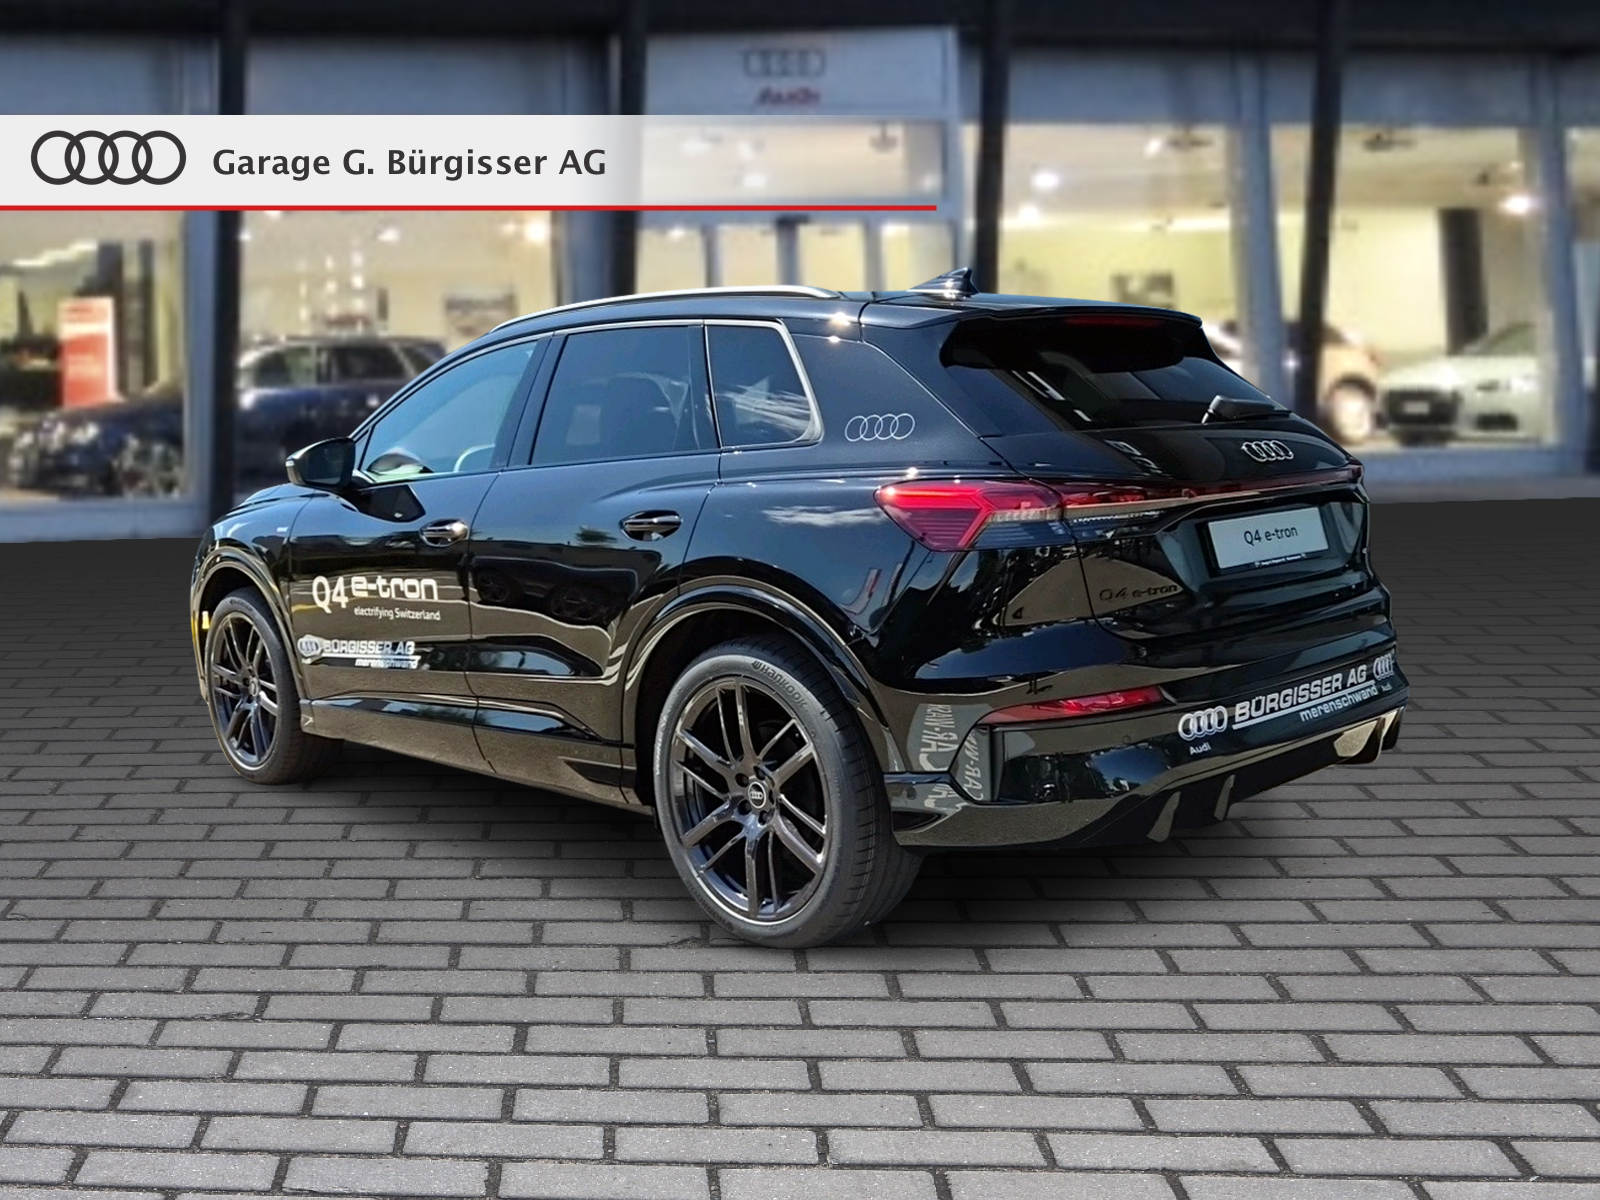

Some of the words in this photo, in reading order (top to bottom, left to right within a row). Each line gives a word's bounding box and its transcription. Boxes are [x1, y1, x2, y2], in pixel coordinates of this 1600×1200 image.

[1243, 530, 1262, 547] Q4
[1265, 525, 1299, 543] e-tron
[312, 575, 349, 614] Q4
[351, 575, 439, 602] e-tron
[1099, 586, 1128, 601] Q4
[1132, 584, 1178, 598] e-tron
[353, 606, 395, 620] electrifying
[395, 607, 441, 622] Switzerland
[395, 640, 415, 656] AG
[1234, 675, 1343, 723] BÜRGISSER
[1346, 663, 1368, 688] AG
[1298, 685, 1379, 722] merenschwand
[1189, 743, 1211, 756] Audi
